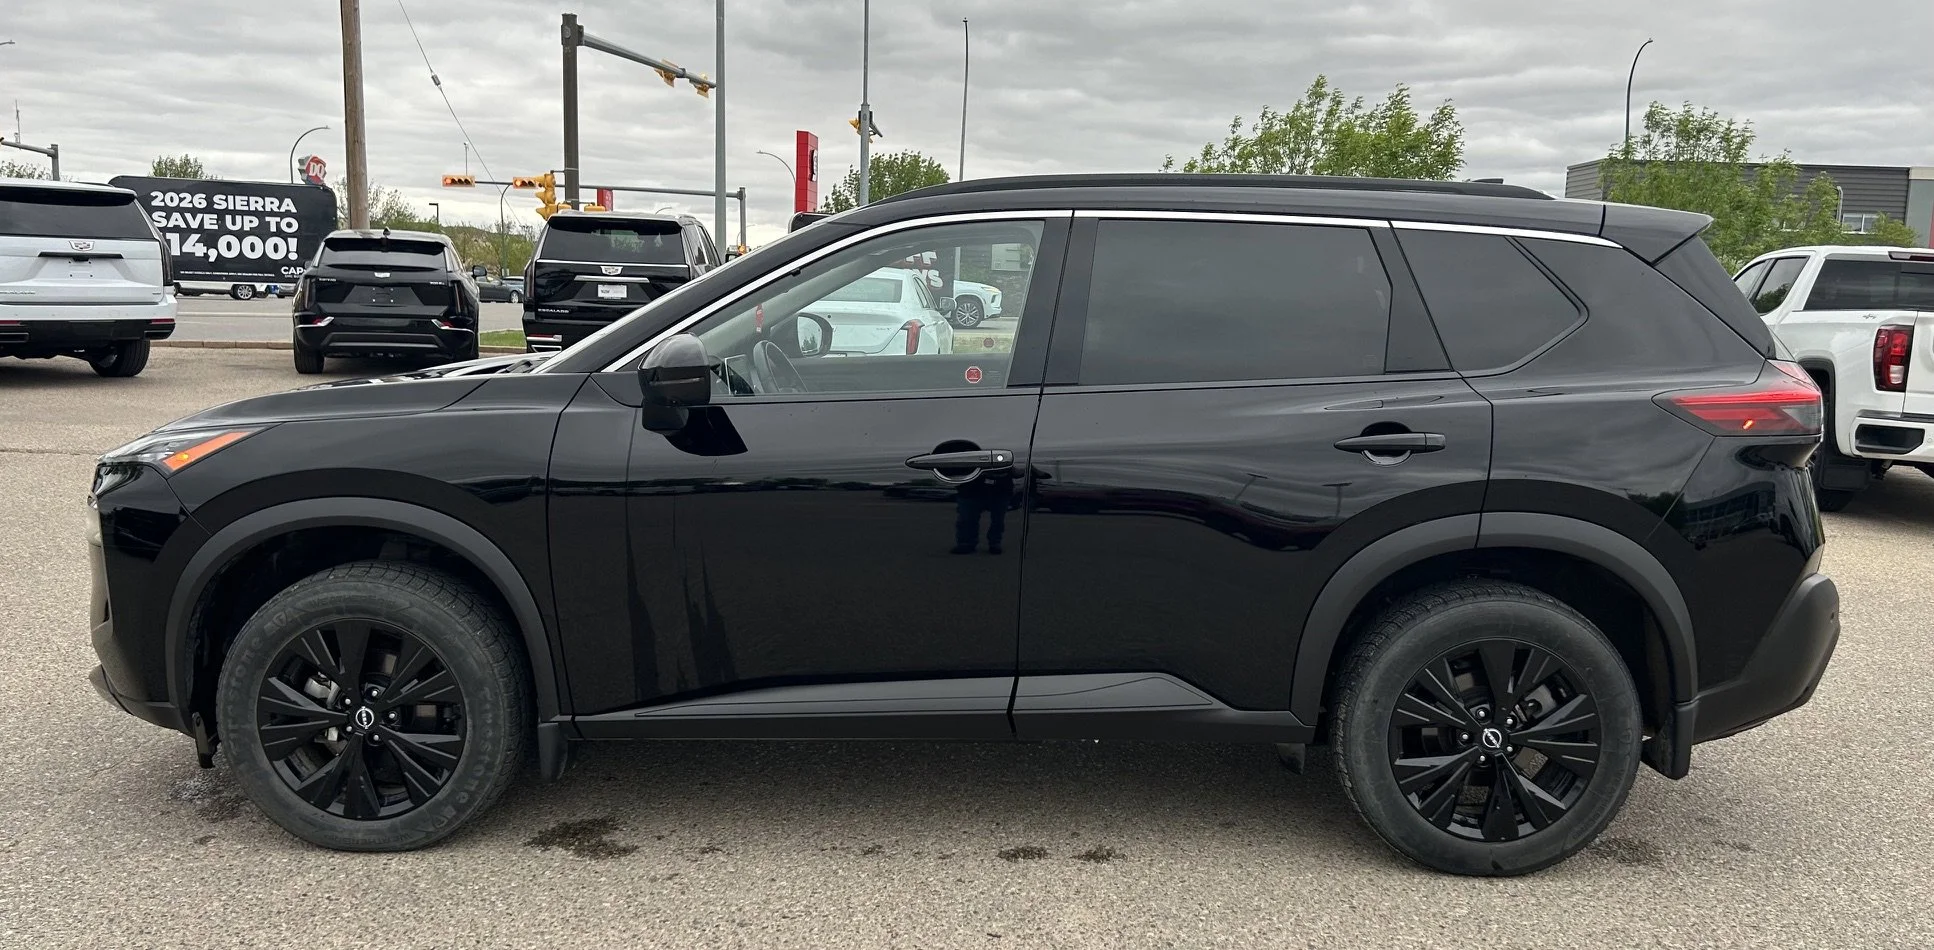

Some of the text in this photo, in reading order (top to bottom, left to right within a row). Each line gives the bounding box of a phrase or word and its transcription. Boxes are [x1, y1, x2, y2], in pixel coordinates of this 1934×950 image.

[309, 161, 325, 180] DQ
[150, 191, 297, 213] 2026 SIERRA
[151, 211, 299, 233] SAVE UP TO
[161, 232, 298, 262] 14,000!
[281, 266, 306, 275] CAP
